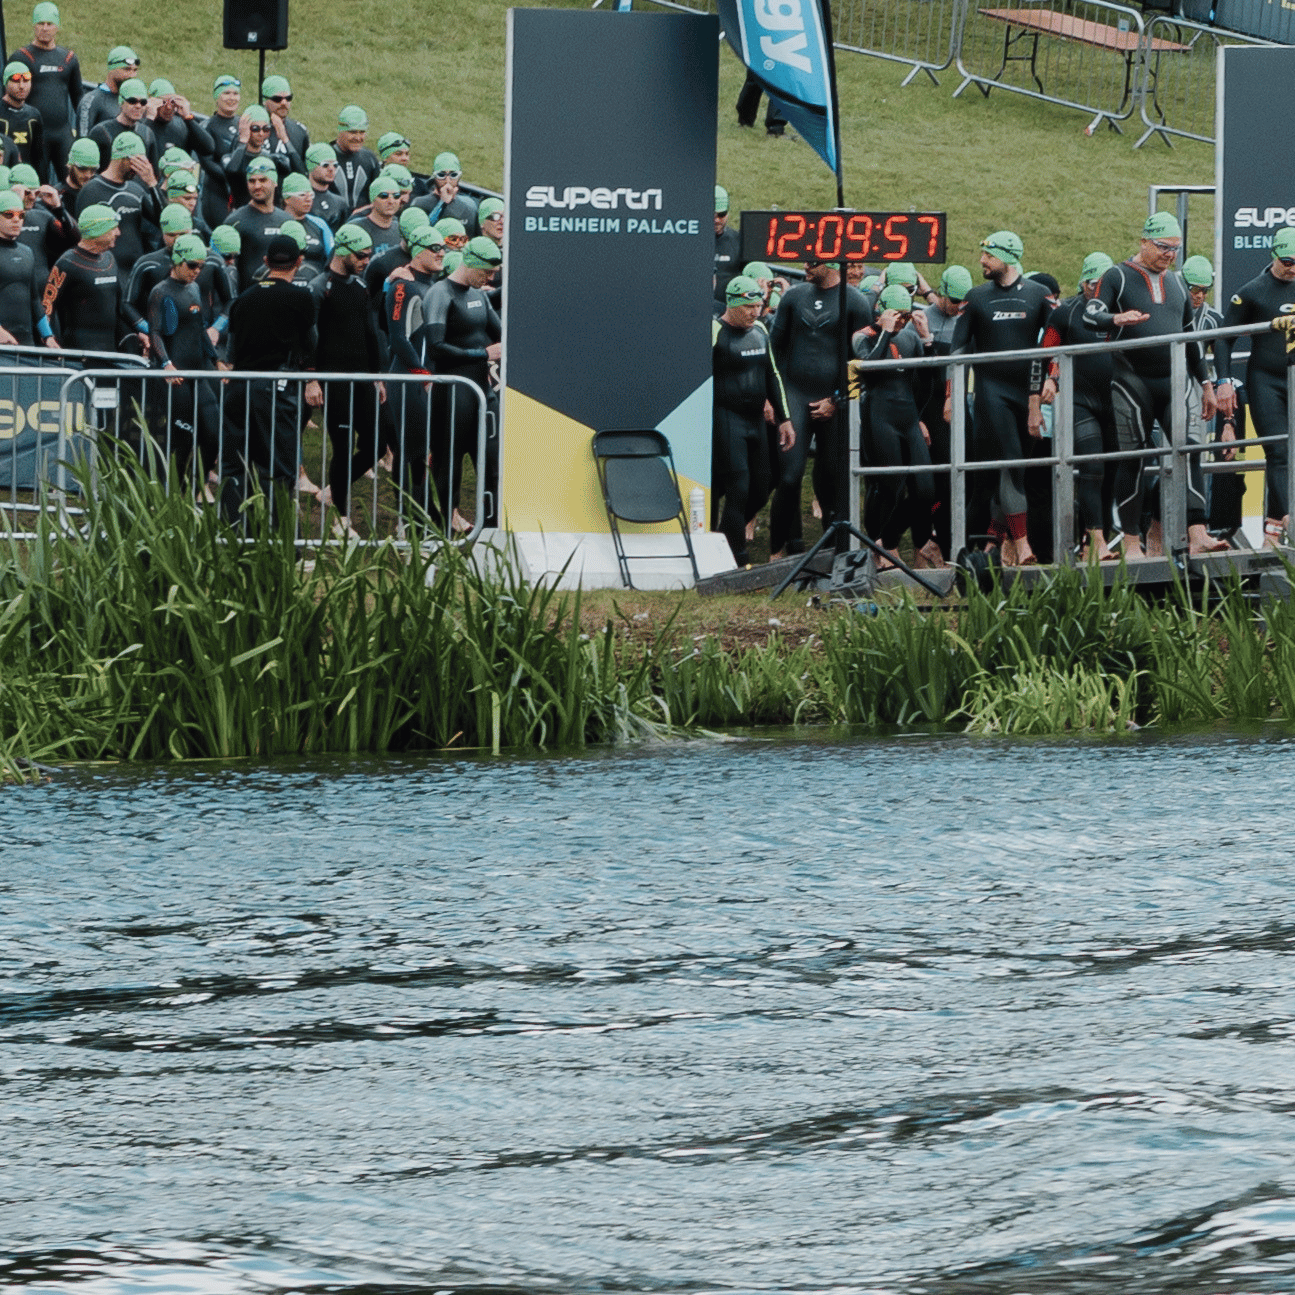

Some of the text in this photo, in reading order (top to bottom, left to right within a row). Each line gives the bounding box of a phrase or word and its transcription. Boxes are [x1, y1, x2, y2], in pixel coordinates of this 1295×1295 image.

[525, 185, 662, 210] supertri
[525, 216, 699, 235] BLENHEIM PALACE
[766, 214, 939, 260] 12:09:57
